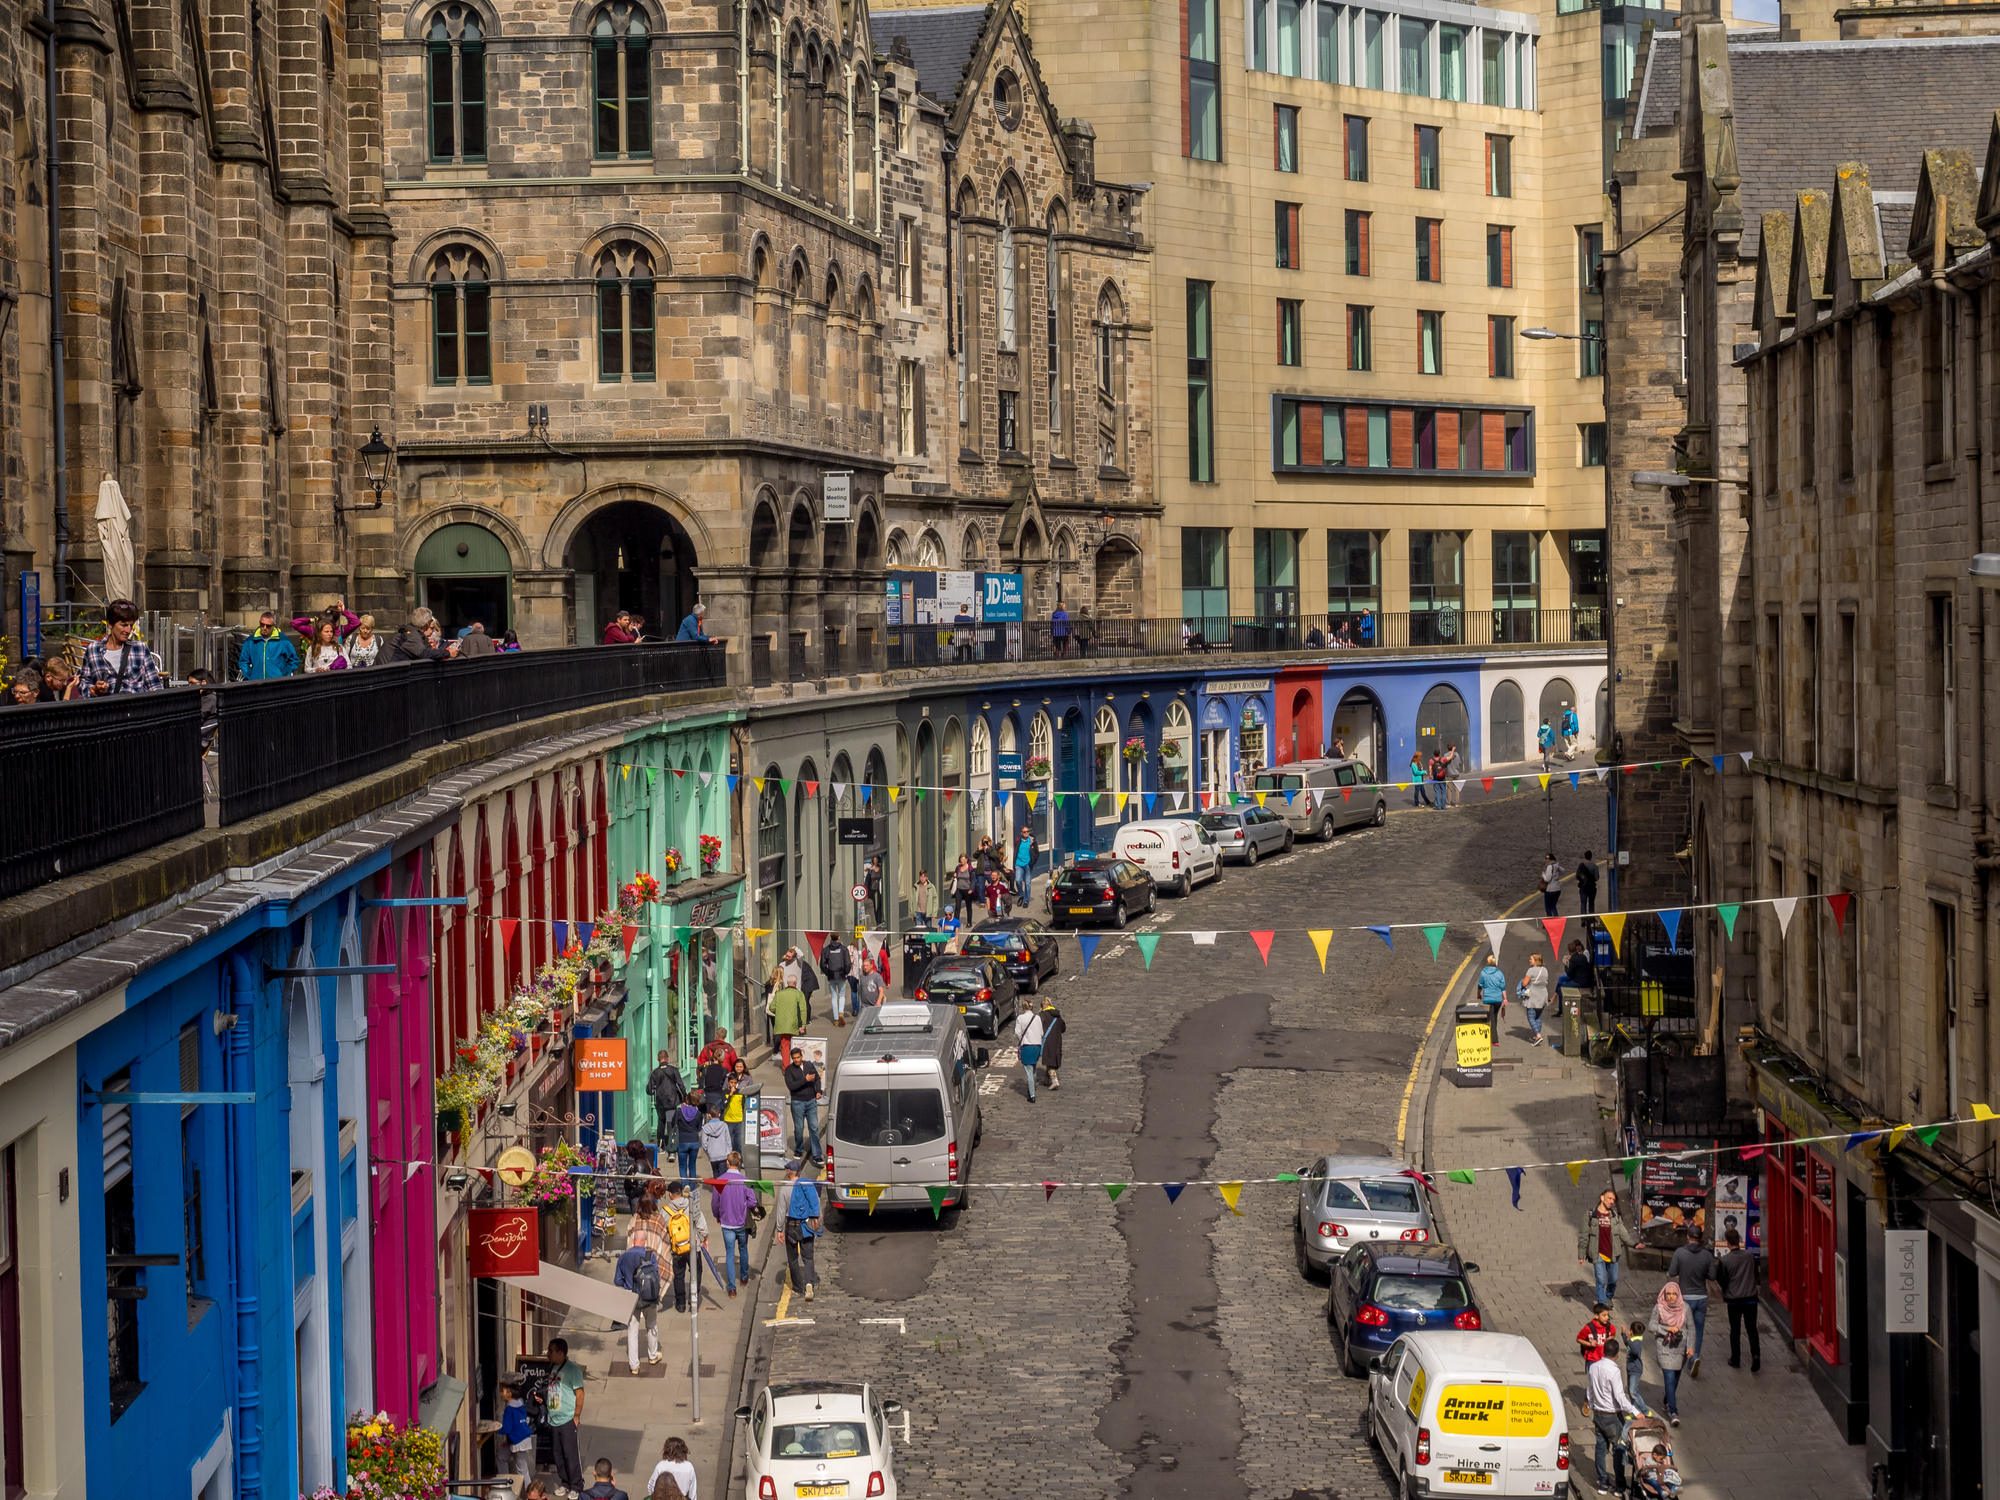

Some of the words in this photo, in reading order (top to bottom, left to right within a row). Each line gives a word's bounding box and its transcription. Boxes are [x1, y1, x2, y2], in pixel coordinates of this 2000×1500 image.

[1003, 579, 1015, 591] John
[986, 578, 1001, 605] JD
[1003, 592, 1021, 604] Dennis
[1209, 683, 1218, 691] THE
[1219, 682, 1227, 690] OLD
[1229, 682, 1241, 690] TOWN
[1242, 680, 1267, 689] BOOKSHOP
[854, 889, 866, 897] 20
[1457, 1028, 1467, 1038] I'm
[1479, 1027, 1490, 1038] bin
[579, 1061, 623, 1069] WHISKY
[750, 1097, 757, 1108] P
[1674, 1161, 1697, 1169] London
[479, 1231, 527, 1247] Demijohn
[1899, 1239, 1920, 1270] sally
[1899, 1272, 1914, 1291] tall
[1899, 1294, 1920, 1324] long
[519, 1363, 548, 1385] Grain
[1444, 1398, 1504, 1410] Arnold
[1511, 1400, 1542, 1408] Branches
[1443, 1409, 1490, 1421] Clark
[1511, 1409, 1549, 1417] throughout
[1457, 1459, 1480, 1468] Hire
[1484, 1461, 1501, 1469] me
[1449, 1474, 1468, 1482] SK17
[1470, 1474, 1487, 1483] XEB
[802, 1487, 821, 1496] SK17
[824, 1486, 841, 1495] CZG
